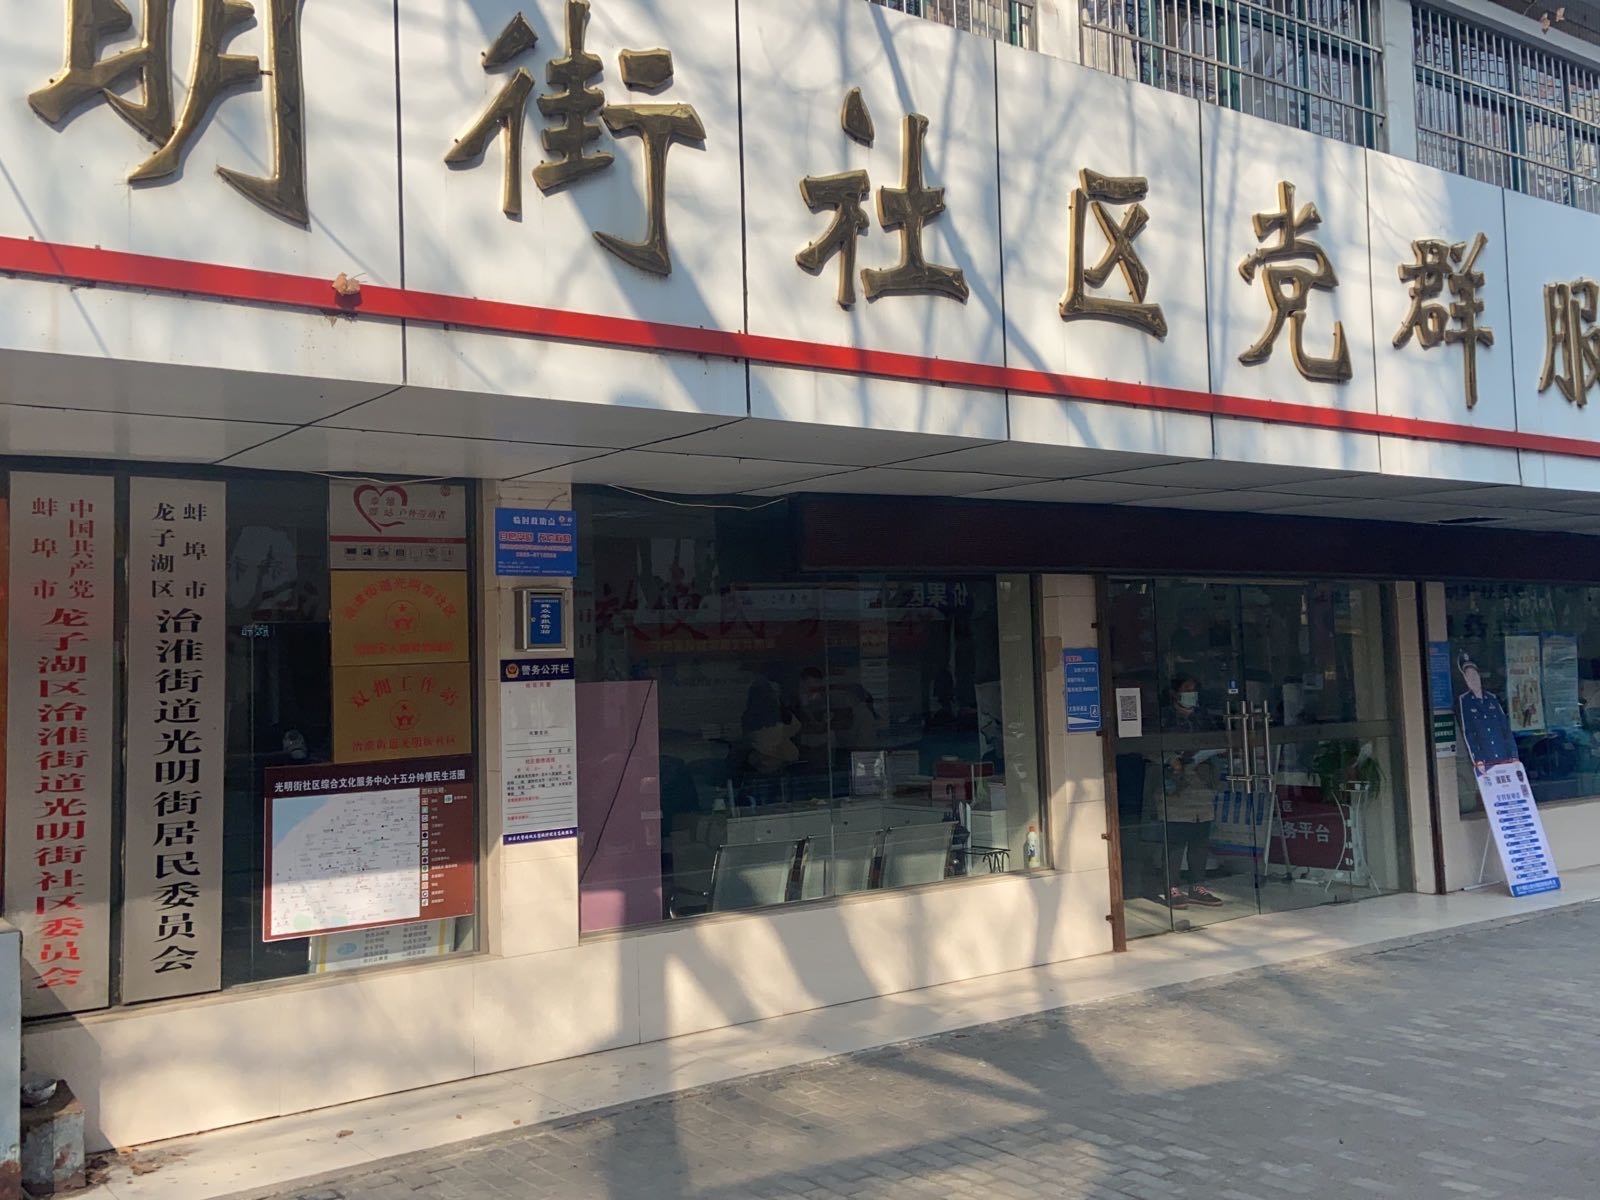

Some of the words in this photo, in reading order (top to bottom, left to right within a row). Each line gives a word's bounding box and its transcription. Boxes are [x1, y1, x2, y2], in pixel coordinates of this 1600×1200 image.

[31, 497, 58, 598] 蚌埠市
[68, 498, 95, 600] 中国共产党
[151, 502, 175, 598] 龙子湖区
[183, 503, 207, 599] 蚌埠市
[521, 664, 570, 676] 警务公开栏
[36, 607, 89, 989] 龙子湖区治淮街道光明街社区委员会
[151, 608, 204, 974] 治淮街道光明街居民委员会
[274, 769, 466, 793] 光明街社区综合文化服务中心十五分钟便民生活圈
